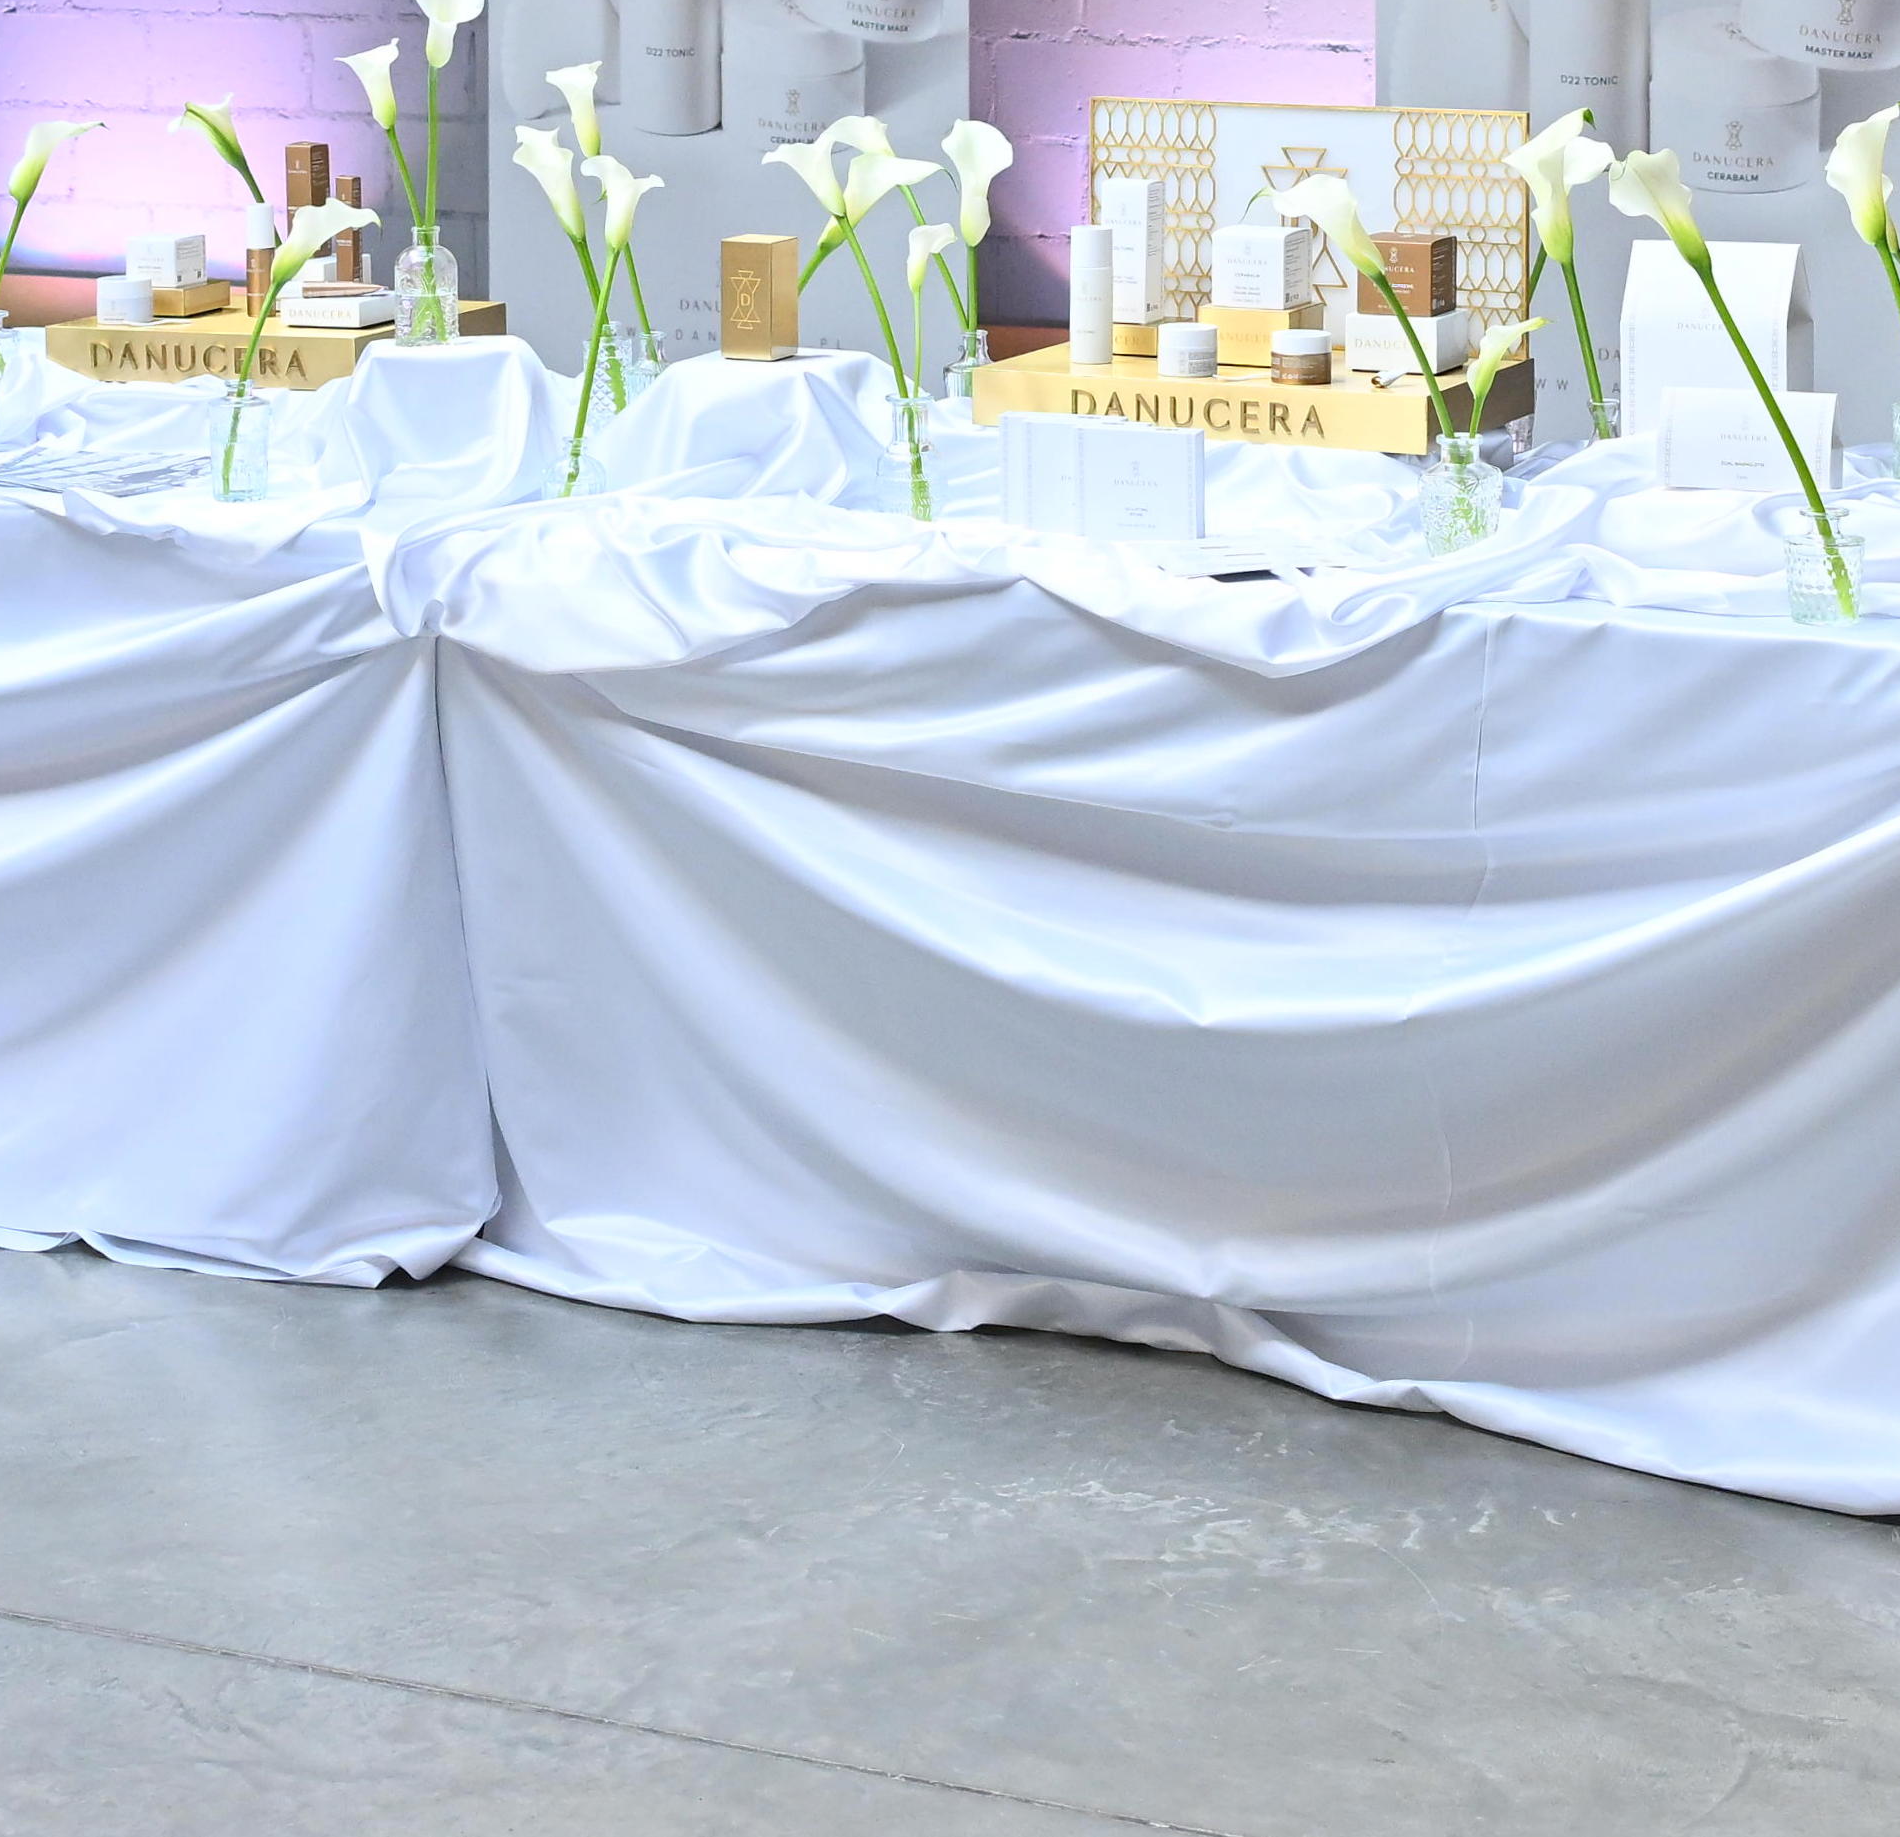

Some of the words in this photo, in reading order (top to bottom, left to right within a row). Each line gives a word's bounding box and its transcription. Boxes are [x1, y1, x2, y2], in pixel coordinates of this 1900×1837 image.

[846, 0, 916, 18] DANUCERA
[851, 18, 886, 32] MASTER
[887, 23, 909, 32] MASK
[1799, 24, 1882, 45] DANUCERA
[645, 46, 663, 57] D22
[666, 47, 696, 58] TONIC
[1805, 45, 1845, 58] MASTER
[1847, 50, 1874, 60] MASK
[1560, 74, 1581, 86] D22
[1583, 75, 1619, 86] TONIC
[1692, 151, 1775, 168] DANUCERA
[1706, 171, 1759, 182] CERABALM
[88, 340, 307, 380] DANUCERA
[1071, 388, 1325, 440] DANUCERA
